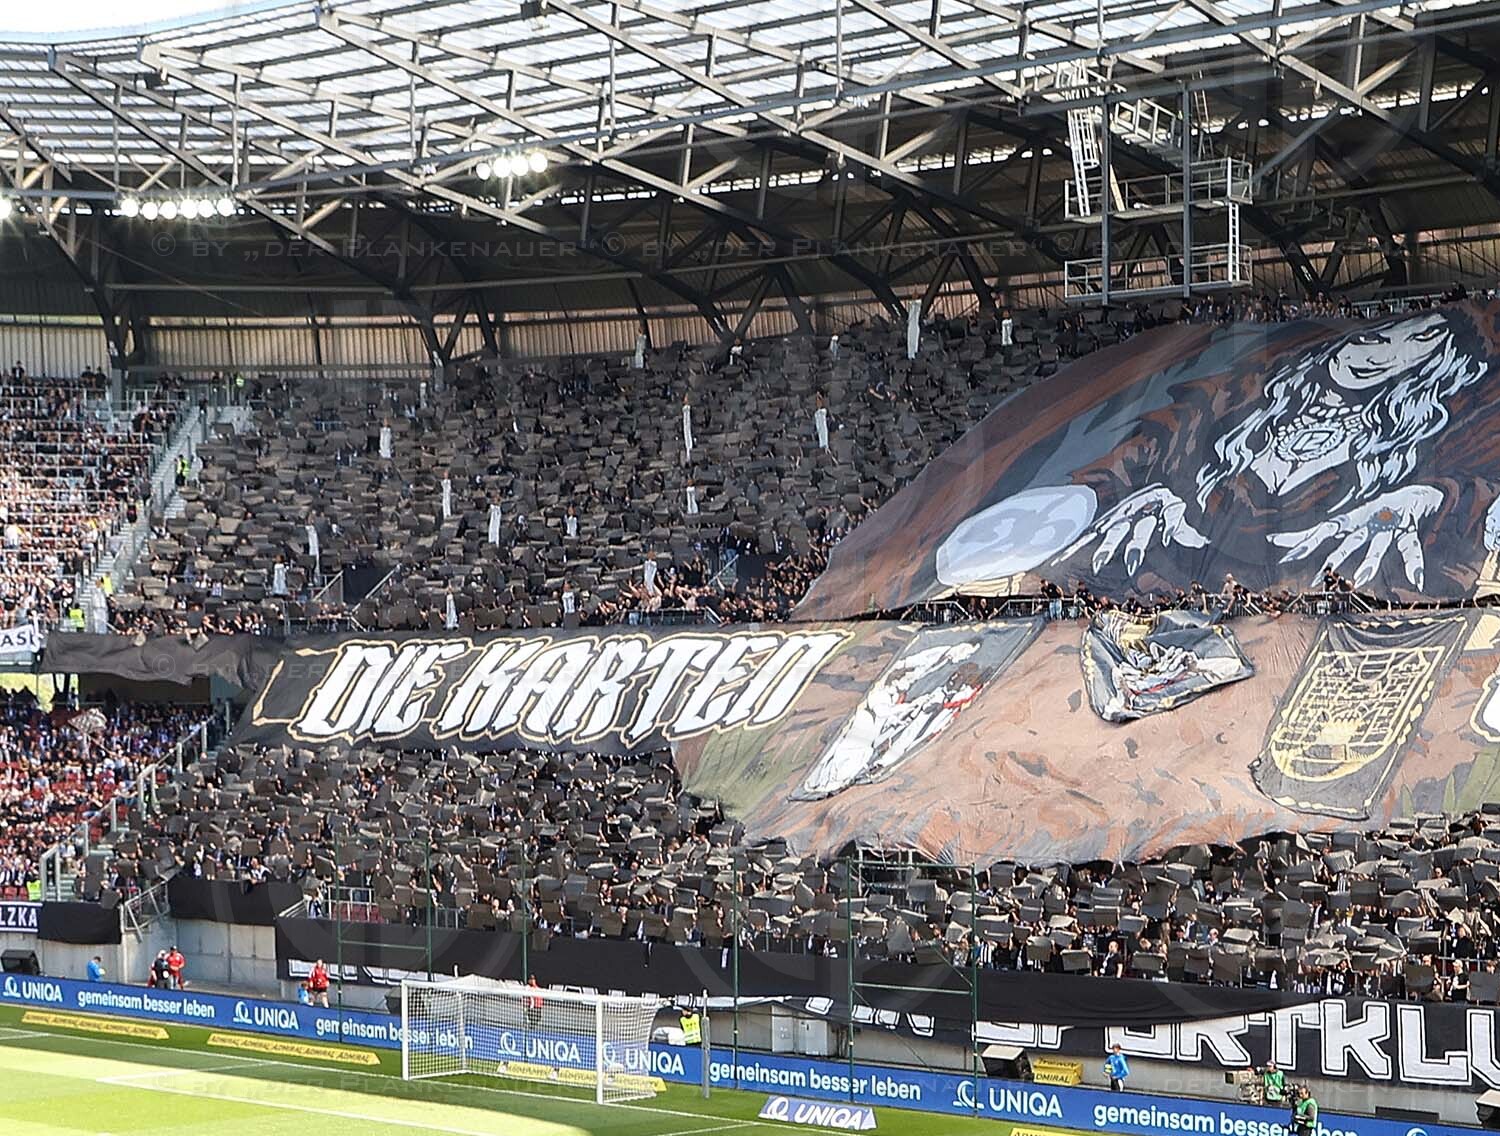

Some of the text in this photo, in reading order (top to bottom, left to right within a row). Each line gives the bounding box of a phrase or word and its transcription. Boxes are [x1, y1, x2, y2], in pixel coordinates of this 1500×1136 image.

[296, 641, 468, 736] DIE
[438, 632, 848, 743] KARTEN
[22, 981, 63, 1002] UNIQA
[78, 990, 142, 1009] gemeinsam
[144, 996, 182, 1014] besser
[183, 999, 215, 1017] leben
[254, 1006, 299, 1030] UNIQA
[526, 1039, 581, 1063] UNIQA
[626, 1050, 685, 1076] UNIQA
[709, 1061, 806, 1087] gemeinsam
[810, 1068, 868, 1094] besser
[871, 1075, 921, 1101] leben
[989, 1088, 1063, 1119] UNIQA
[1094, 1105, 1215, 1134] gemeinsam
[1033, 1072, 1071, 1083] DMIRAL
[794, 1101, 864, 1129] UNIQA
